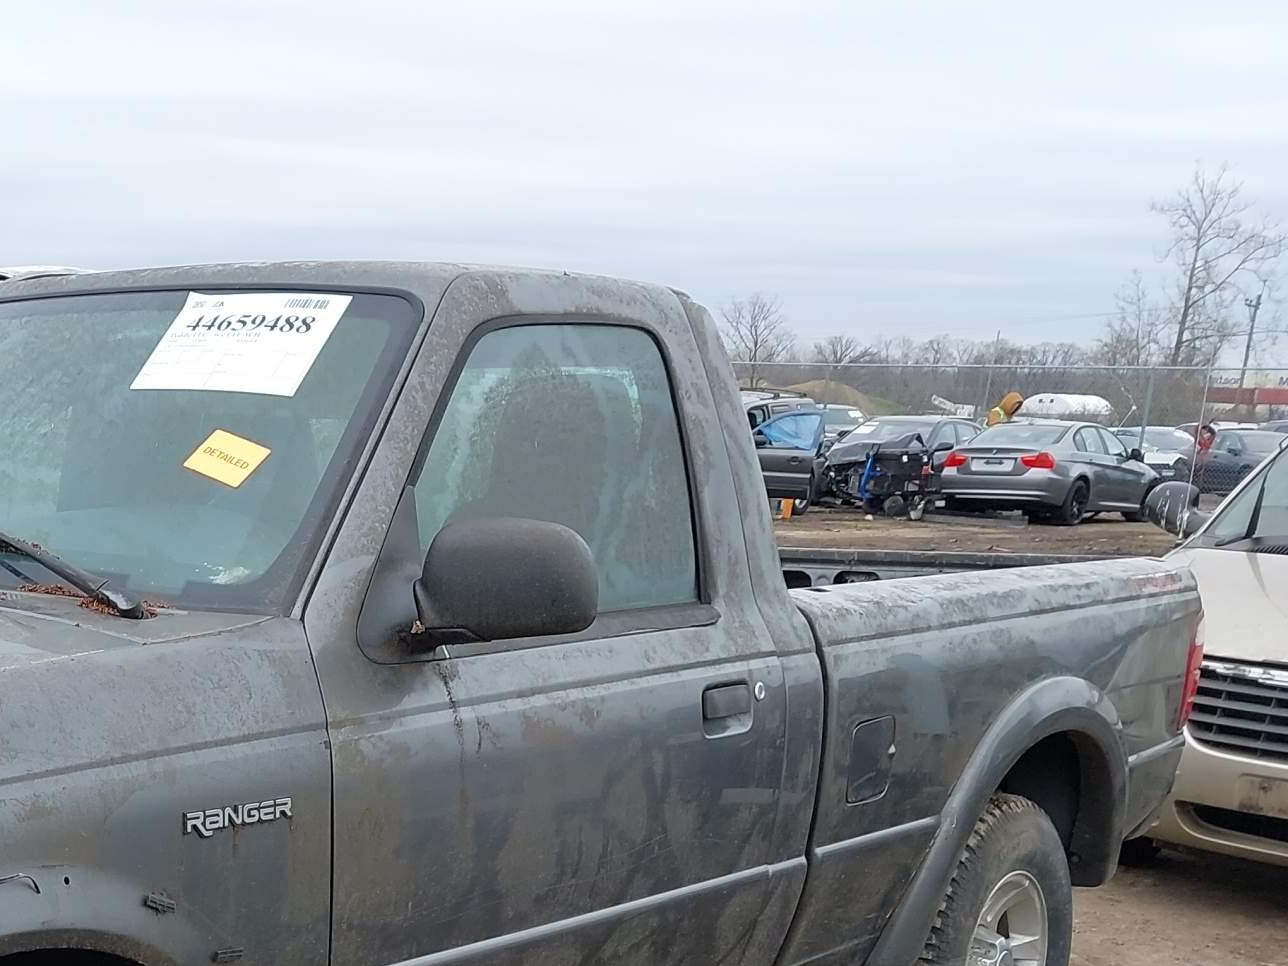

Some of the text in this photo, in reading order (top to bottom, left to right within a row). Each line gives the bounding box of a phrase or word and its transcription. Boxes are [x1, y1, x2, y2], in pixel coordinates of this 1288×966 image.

[186, 314, 316, 334] 44659488
[202, 445, 250, 471] DETAILED
[185, 797, 293, 837] RANGER
